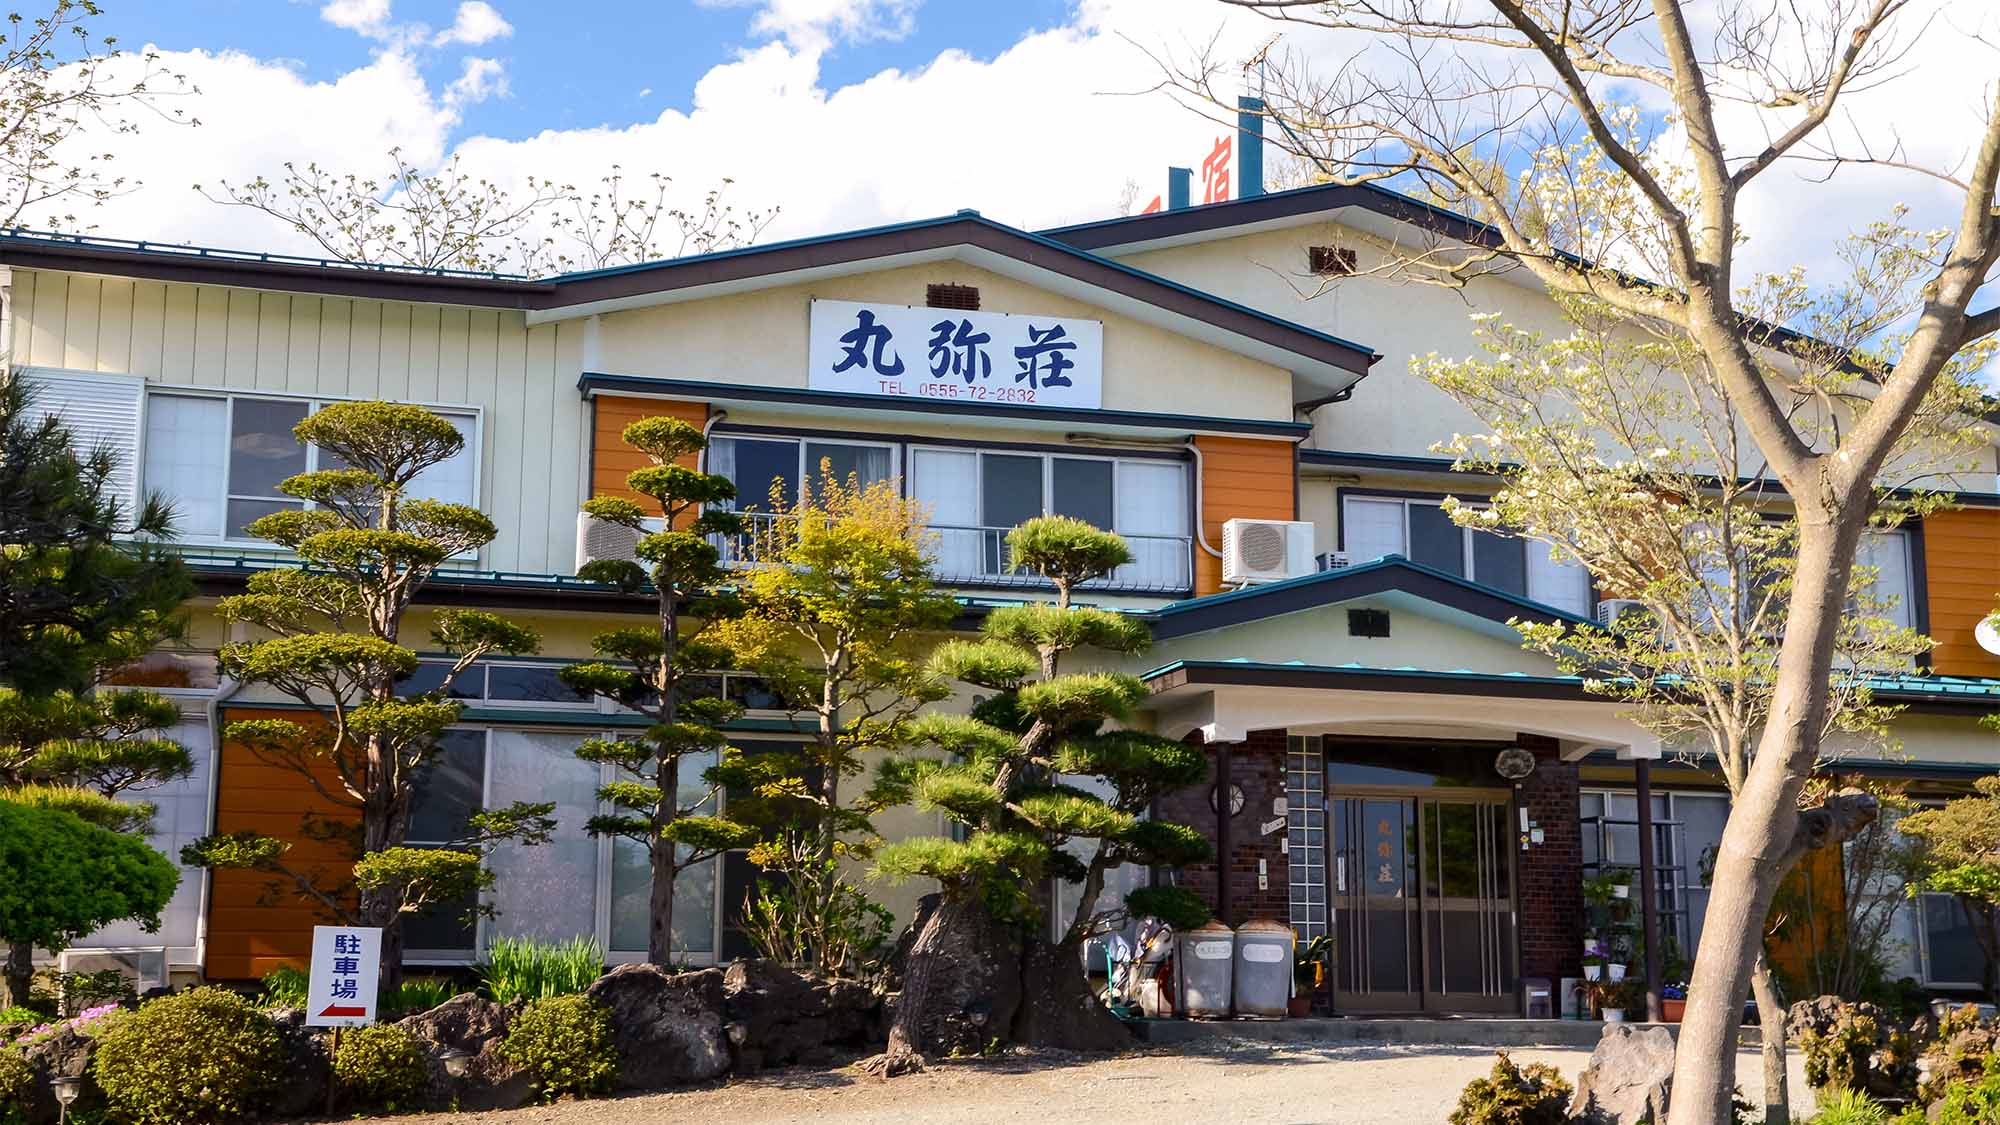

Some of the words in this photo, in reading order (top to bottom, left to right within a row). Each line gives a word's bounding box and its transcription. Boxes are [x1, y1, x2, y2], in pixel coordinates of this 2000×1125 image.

[832, 309, 1077, 389] 丸弥荘
[879, 381, 907, 395] TEL
[919, 383, 1036, 403] 0555-72-2832
[331, 934, 361, 999] 駐車場
